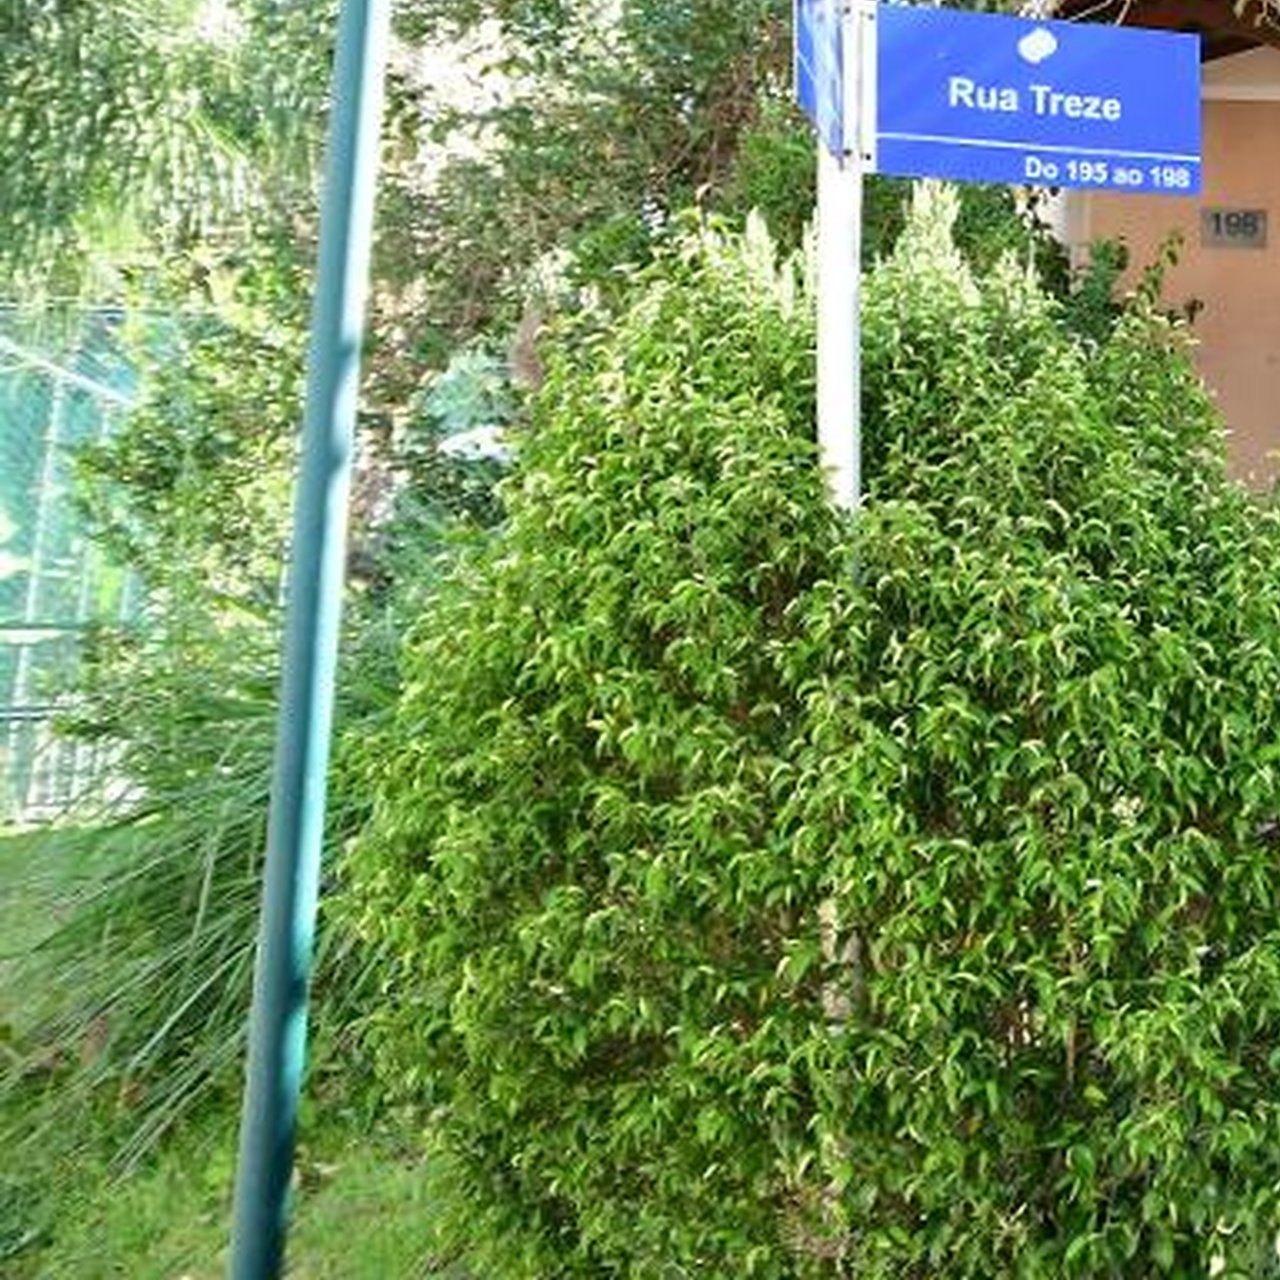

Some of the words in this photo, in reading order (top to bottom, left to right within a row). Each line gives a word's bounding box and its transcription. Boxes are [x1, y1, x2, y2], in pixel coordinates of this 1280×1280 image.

[948, 76, 1019, 112] Rua
[1028, 84, 1122, 120] Treze
[1025, 156, 1059, 181] Do
[1068, 159, 1107, 184] 195
[1113, 166, 1143, 186] ao
[1150, 165, 1191, 189] 198
